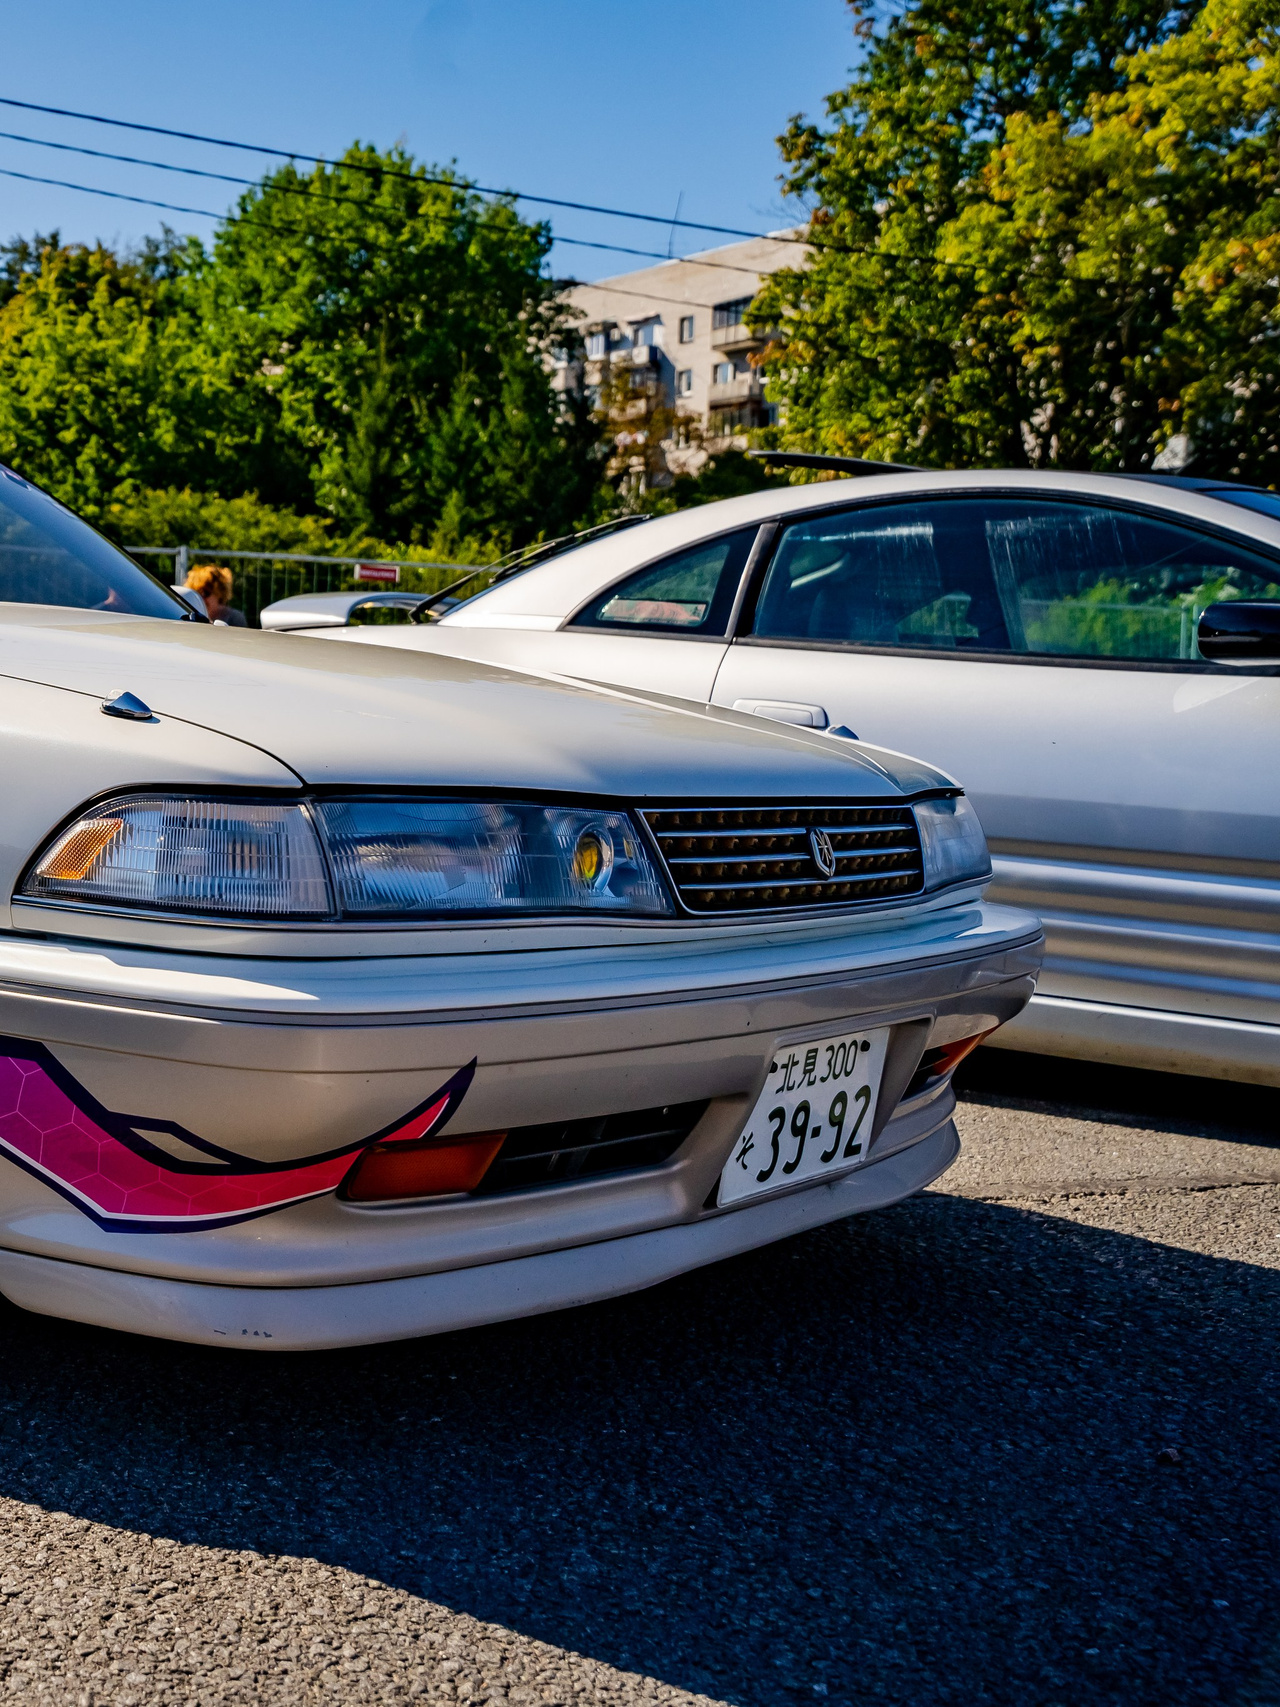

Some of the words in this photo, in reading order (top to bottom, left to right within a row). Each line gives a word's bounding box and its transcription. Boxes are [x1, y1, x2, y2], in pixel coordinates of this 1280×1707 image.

[775, 1047, 819, 1094] 北見
[820, 1039, 858, 1083] 300
[756, 1085, 872, 1183] 39-92
